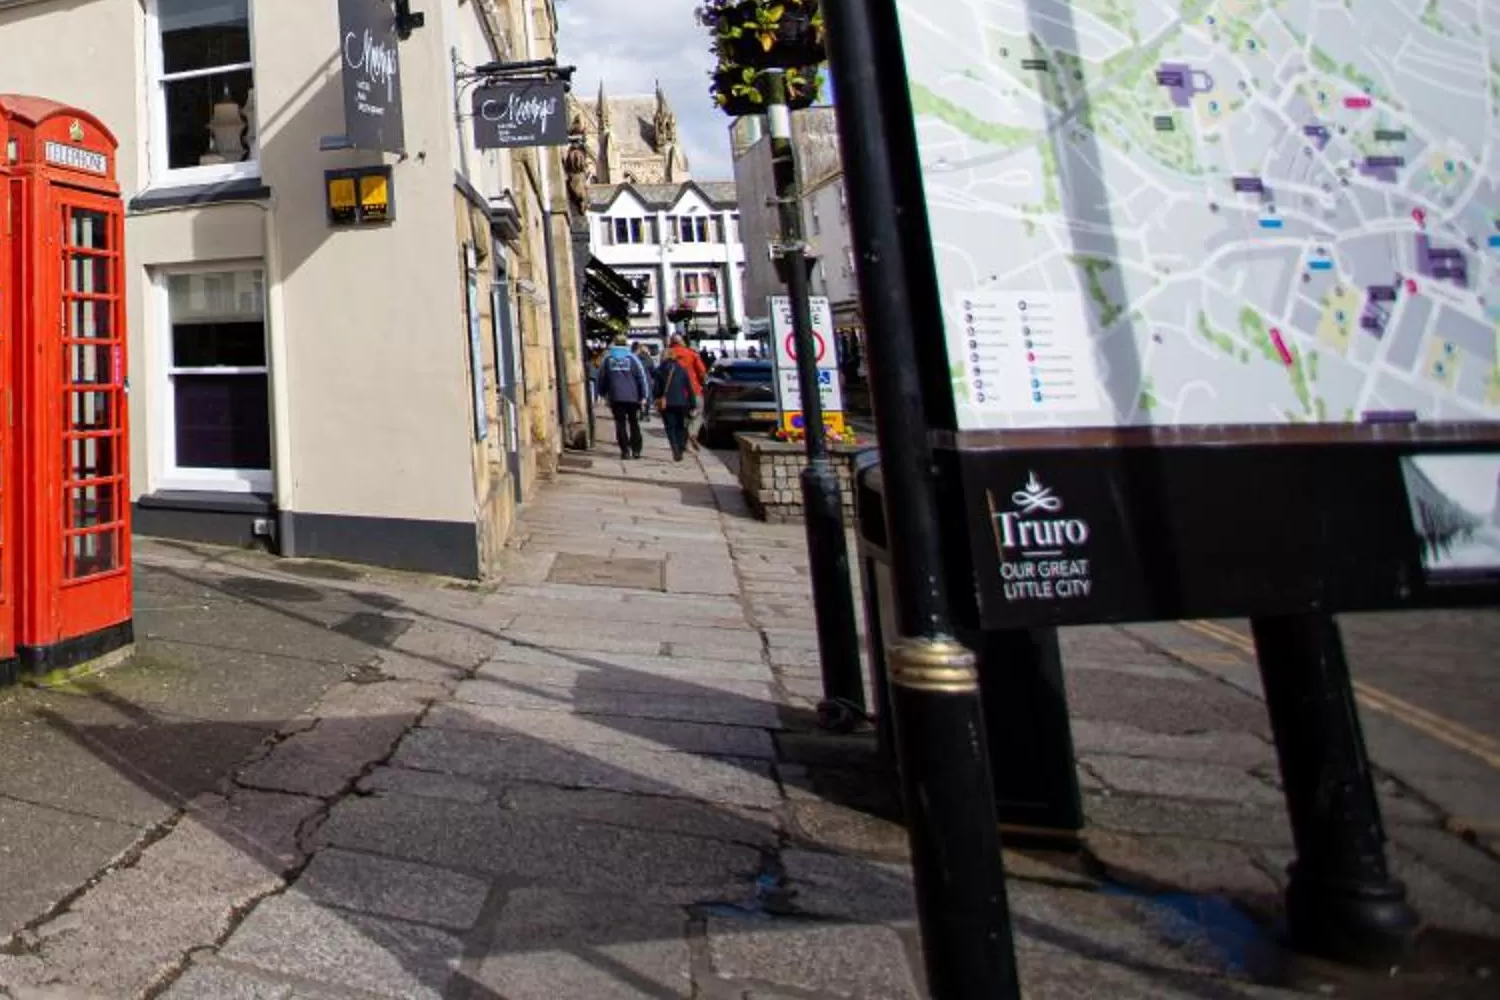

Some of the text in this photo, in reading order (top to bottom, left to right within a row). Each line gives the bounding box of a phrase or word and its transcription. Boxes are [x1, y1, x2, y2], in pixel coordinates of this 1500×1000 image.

[47, 142, 104, 171] TELEPHONE
[992, 510, 1091, 547] Truro
[1000, 559, 1089, 580] OUR GREAT
[1004, 578, 1092, 601] LITTLE CITY
